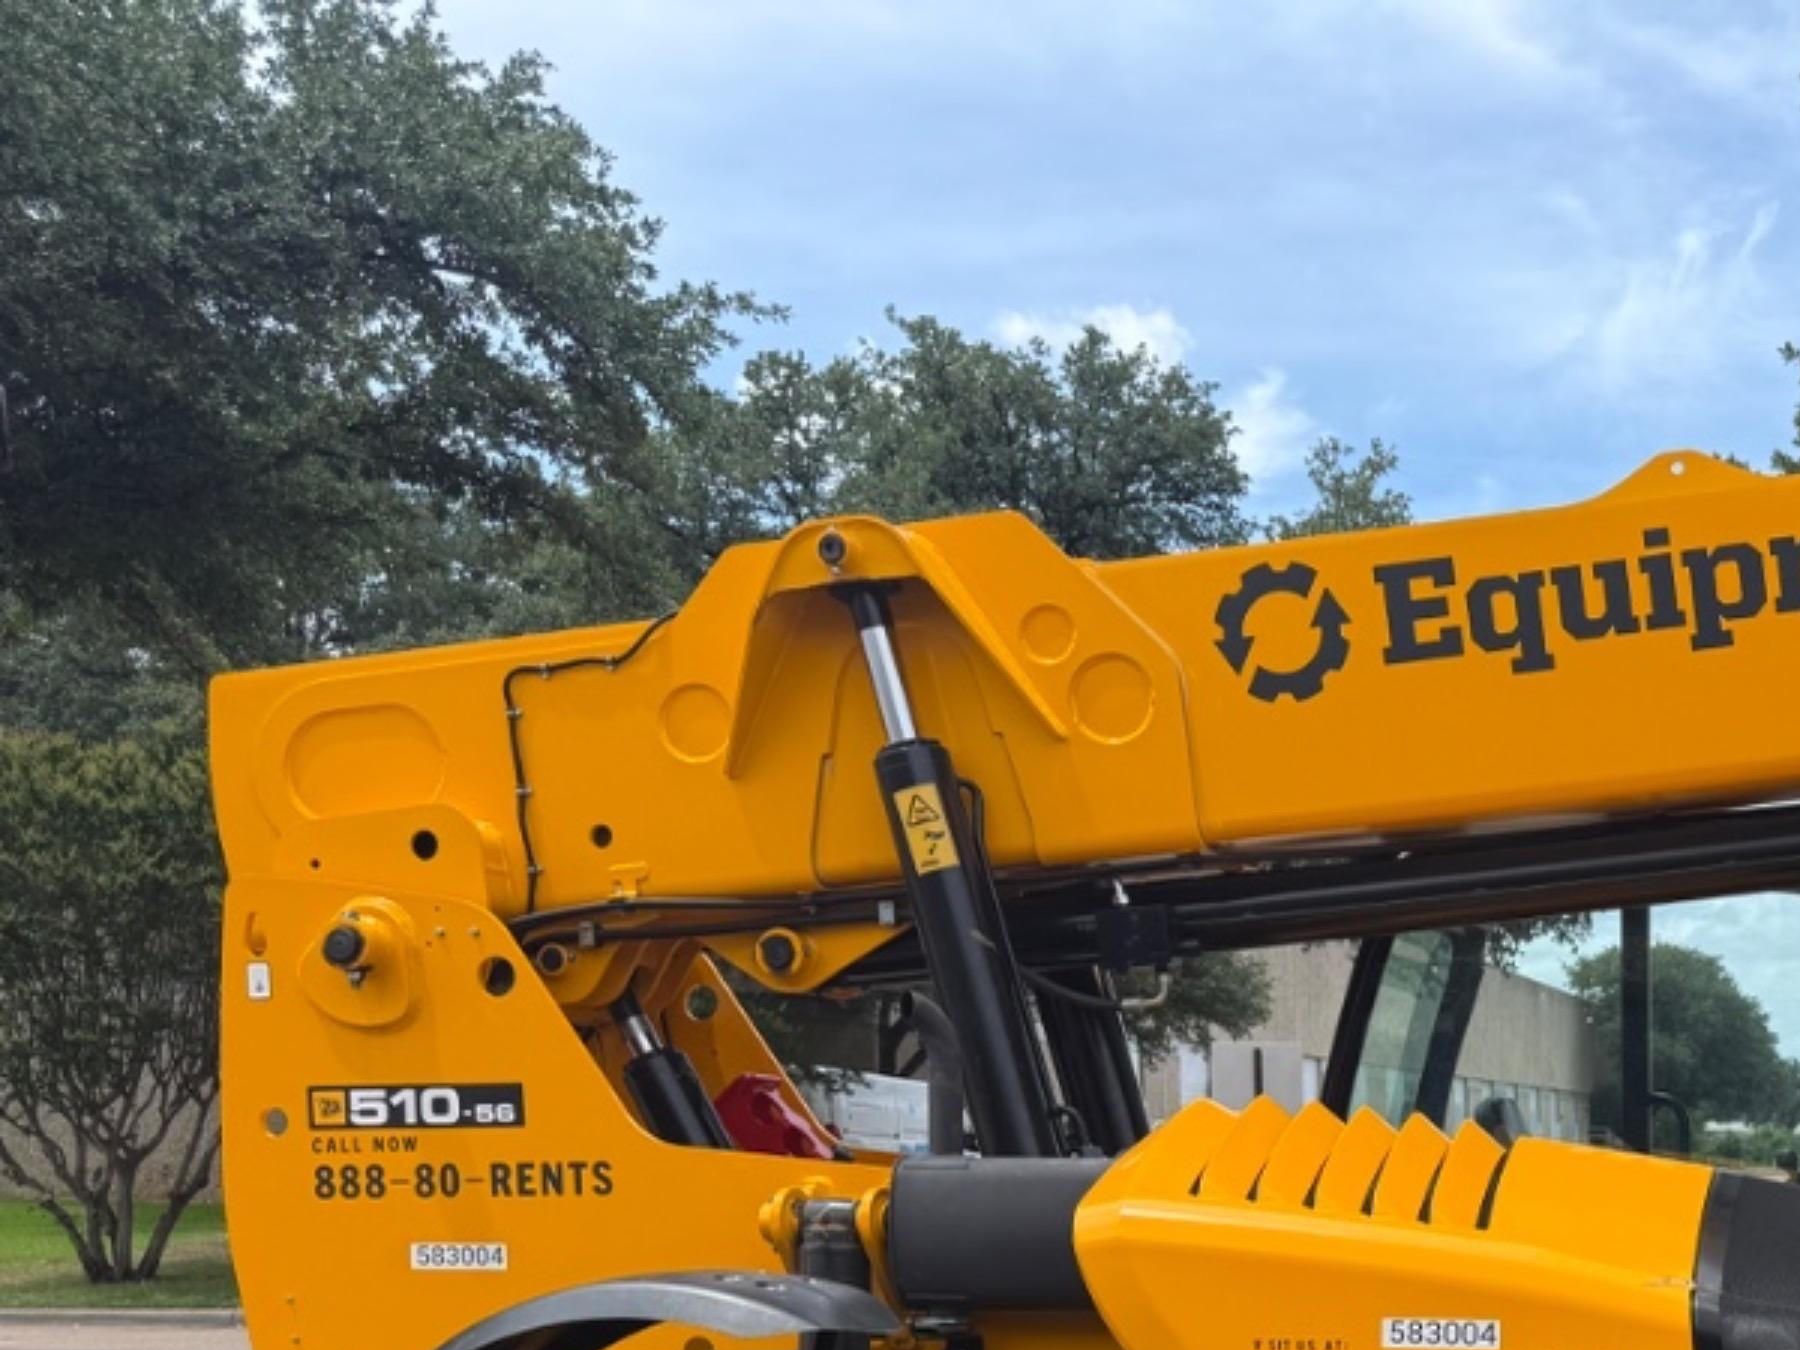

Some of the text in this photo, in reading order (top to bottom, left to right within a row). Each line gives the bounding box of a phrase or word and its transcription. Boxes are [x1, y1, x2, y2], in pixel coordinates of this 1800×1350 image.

[311, 1136, 418, 1154] CALL NOW
[313, 1160, 613, 1200] 888-80-RENTS
[415, 1246, 503, 1266] 583004
[1391, 1319, 1497, 1346] 583004
